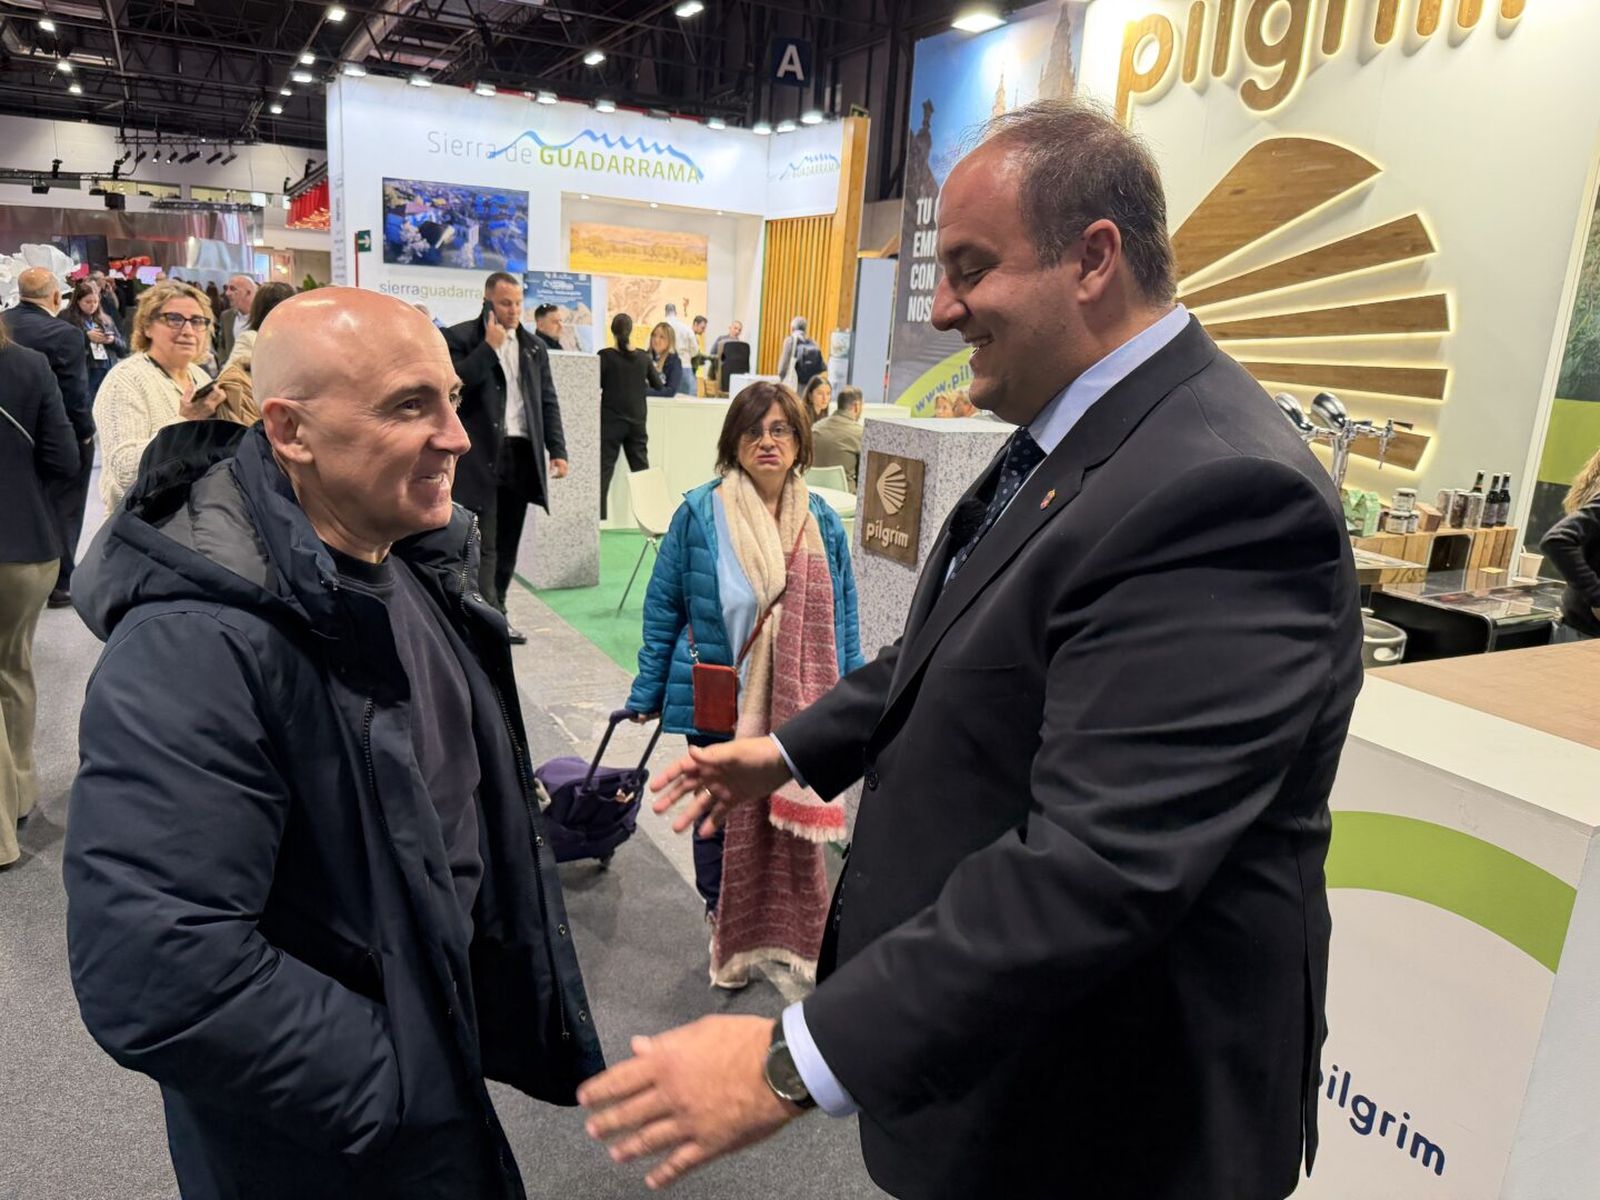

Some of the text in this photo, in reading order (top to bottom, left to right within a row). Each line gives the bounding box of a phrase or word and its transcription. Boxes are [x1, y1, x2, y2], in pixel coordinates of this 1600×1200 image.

[776, 43, 805, 81] A
[427, 130, 701, 184] Sierra de GUADARRAMA
[916, 197, 932, 226] TU
[910, 263, 936, 290] CON
[907, 295, 934, 322] NOS
[865, 519, 909, 548] pilgrim
[1318, 1064, 1446, 1176] ilgrim
